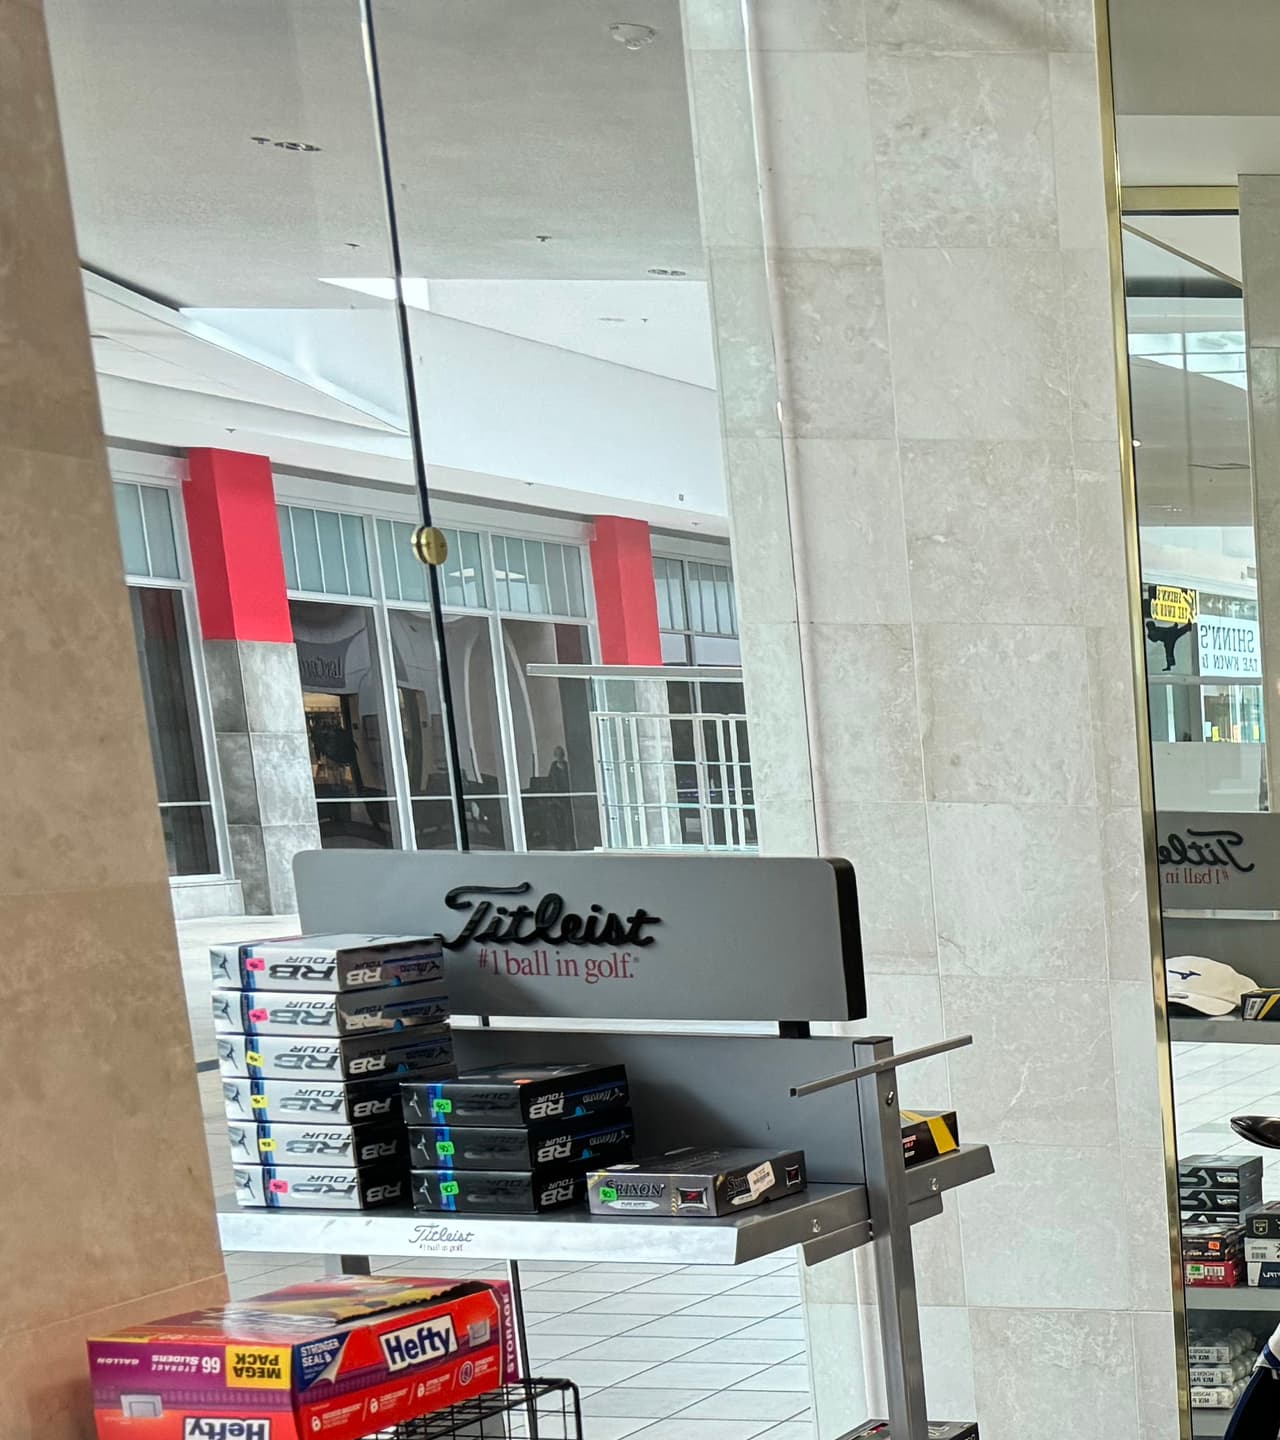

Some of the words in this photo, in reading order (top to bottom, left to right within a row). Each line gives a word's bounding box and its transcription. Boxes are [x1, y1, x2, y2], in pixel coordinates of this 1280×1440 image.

[434, 881, 662, 951] Titleist
[270, 964, 336, 981] RB
[477, 948, 501, 976] #1
[504, 950, 551, 977] ball
[555, 950, 580, 978] in
[346, 966, 382, 985] RB
[529, 1098, 565, 1119] RB
[537, 1141, 572, 1163] RB
[541, 1184, 575, 1206] RB
[408, 1223, 475, 1244] Titleist
[506, 1292, 516, 1374] STORAGE
[385, 1325, 451, 1364] Hefty
[151, 1354, 200, 1366] SLIDERS
[201, 1356, 221, 1374] 66
[235, 1352, 280, 1366] PACK
[302, 1352, 325, 1367] SEAL
[233, 1366, 281, 1379] MEGA
